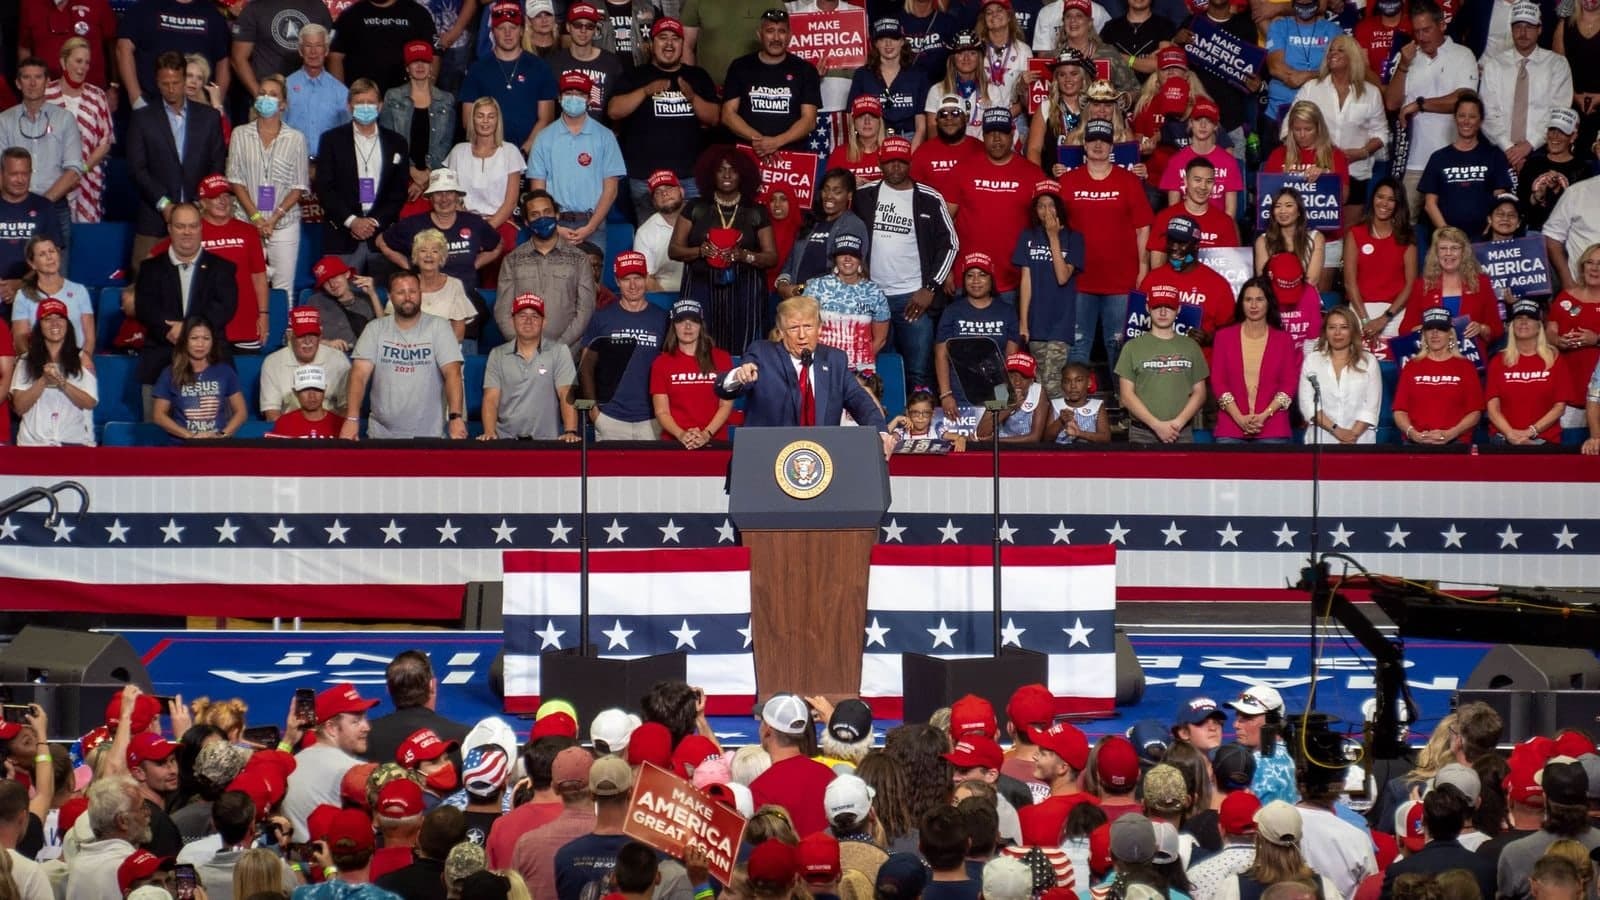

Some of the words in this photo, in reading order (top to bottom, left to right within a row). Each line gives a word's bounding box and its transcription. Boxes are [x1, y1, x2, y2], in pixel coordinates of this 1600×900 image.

[161, 15, 205, 26] TRUMP
[808, 20, 840, 31] MAKE
[789, 32, 863, 48] AMERICA
[905, 33, 940, 48] RUMP
[1211, 33, 1242, 55] MAKE
[828, 47, 864, 57] AGAIN
[1184, 44, 1219, 65] GREAT
[751, 85, 791, 94] LATINOS
[752, 98, 788, 110] TRUMP
[1443, 165, 1488, 174] TRUMP
[974, 179, 1019, 189] TRUMP
[1283, 182, 1317, 191] MAKE
[1074, 191, 1119, 199] TRUMP
[882, 212, 913, 227] Voices
[201, 238, 244, 247] TRUMP
[1488, 248, 1521, 260] MAKE
[1481, 258, 1545, 276] MERICA
[1510, 273, 1547, 287] AGAIN
[958, 320, 1004, 328] TRUMP
[382, 345, 431, 360] TRUMP
[1505, 371, 1550, 380] TRUMP
[672, 788, 713, 821] MAKE
[637, 791, 732, 857] AMERICA
[632, 810, 685, 841] GREAT
[687, 837, 731, 872] AGAIN
